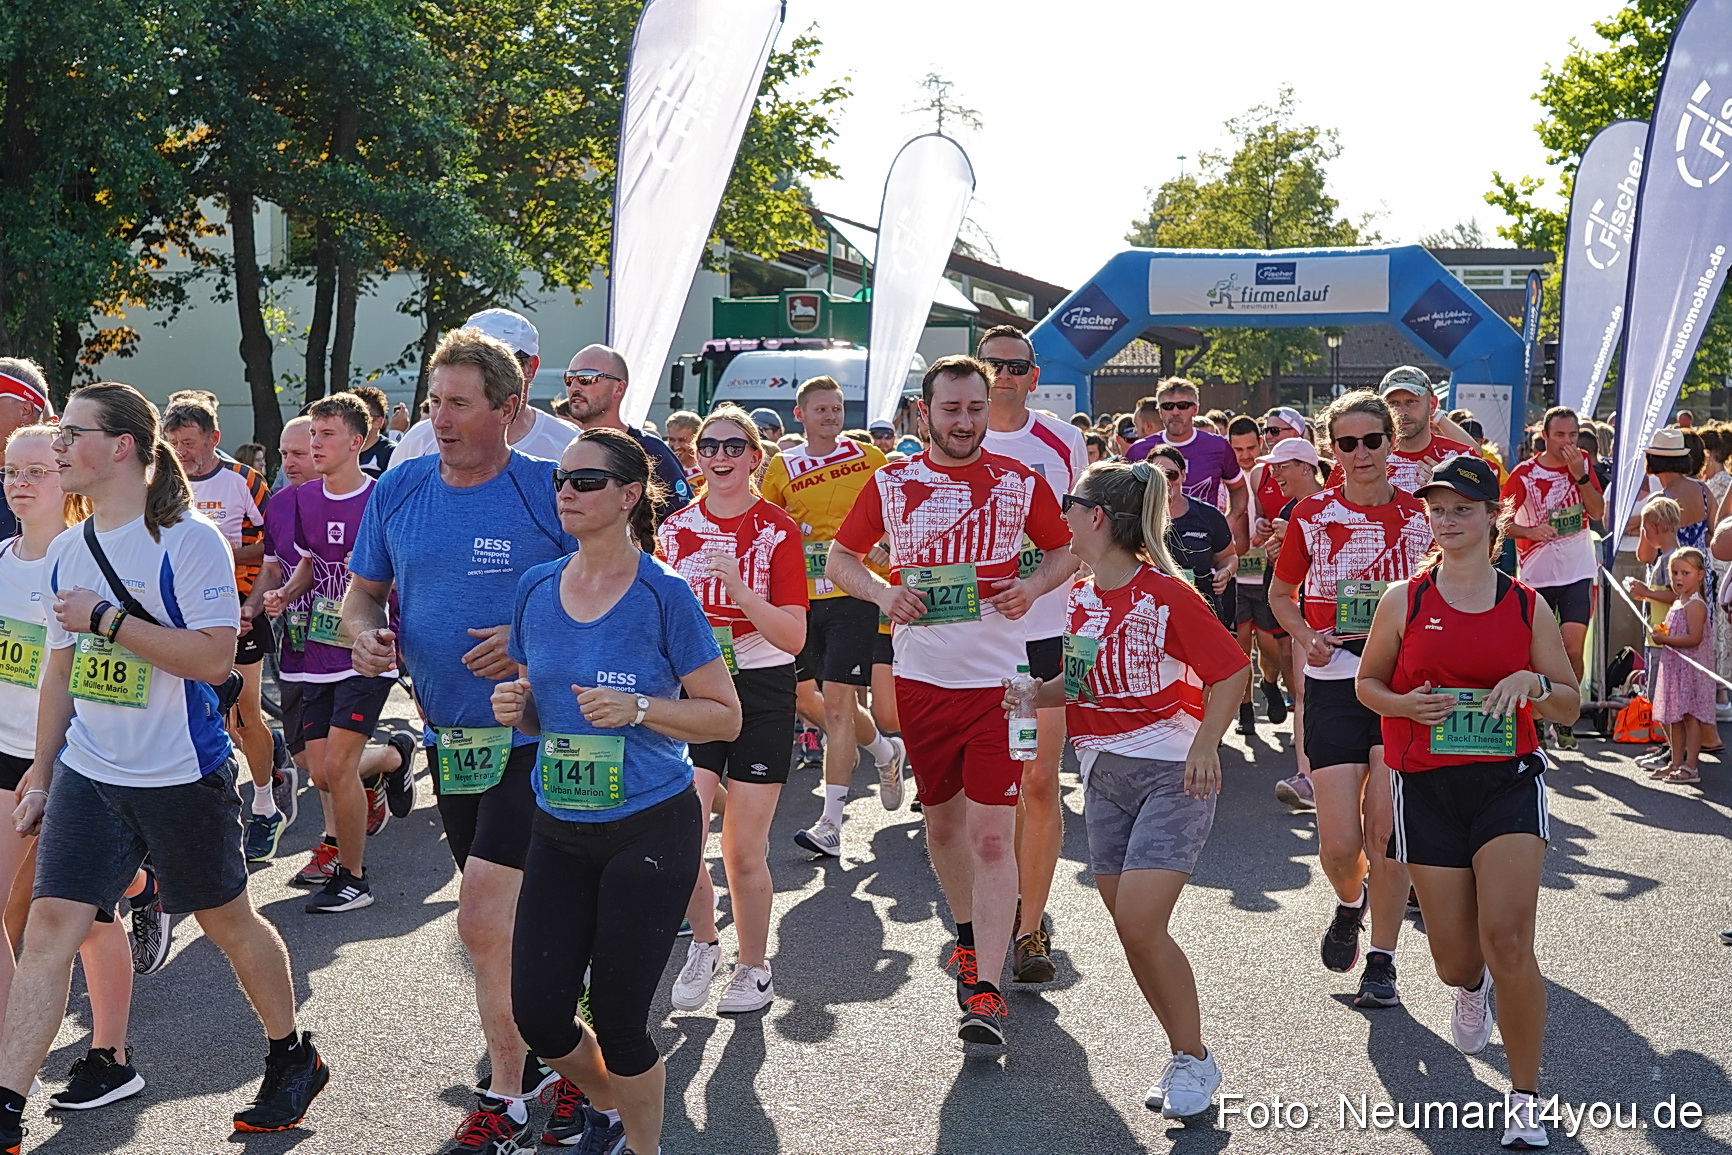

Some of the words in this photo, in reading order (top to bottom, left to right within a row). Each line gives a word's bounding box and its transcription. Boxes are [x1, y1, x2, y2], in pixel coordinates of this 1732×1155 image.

[1599, 146, 1644, 250] Fischer
[1241, 285, 1330, 302] firmenlauf
[1070, 314, 1119, 326] Fischer
[791, 473, 826, 493] MAX
[829, 461, 871, 480] BÖGL
[926, 517, 949, 525] 26.22
[1556, 514, 1580, 528] 1099
[473, 537, 512, 551] DESS
[473, 549, 510, 558] Transporte
[471, 556, 510, 565] Logistik
[1348, 557, 1368, 565] 26.22
[966, 586, 976, 613] 2022
[317, 613, 343, 630] 157
[1340, 603, 1348, 622] RUN
[28, 650, 40, 680] 2022
[723, 647, 734, 669] 2022
[5, 663, 30, 675] Sophia
[72, 656, 82, 689] WALK
[86, 657, 127, 683] 318
[596, 670, 637, 686] DESS
[1064, 658, 1085, 679] 130
[82, 679, 104, 690] Müller
[105, 683, 129, 694] Mario
[135, 667, 147, 699] 2022
[1436, 721, 1445, 741] RU
[1447, 711, 1504, 734] 1172
[1505, 716, 1513, 747] 2022
[1447, 735, 1471, 743] Rackl
[1473, 735, 1503, 743] Theresa
[442, 757, 450, 780] RUN
[453, 747, 494, 771] 142
[496, 748, 509, 777] 2022
[454, 773, 472, 782] Meyer
[554, 760, 596, 785] 141
[609, 766, 619, 799] 2022
[550, 785, 572, 795] Urban
[574, 787, 604, 797] Marion
